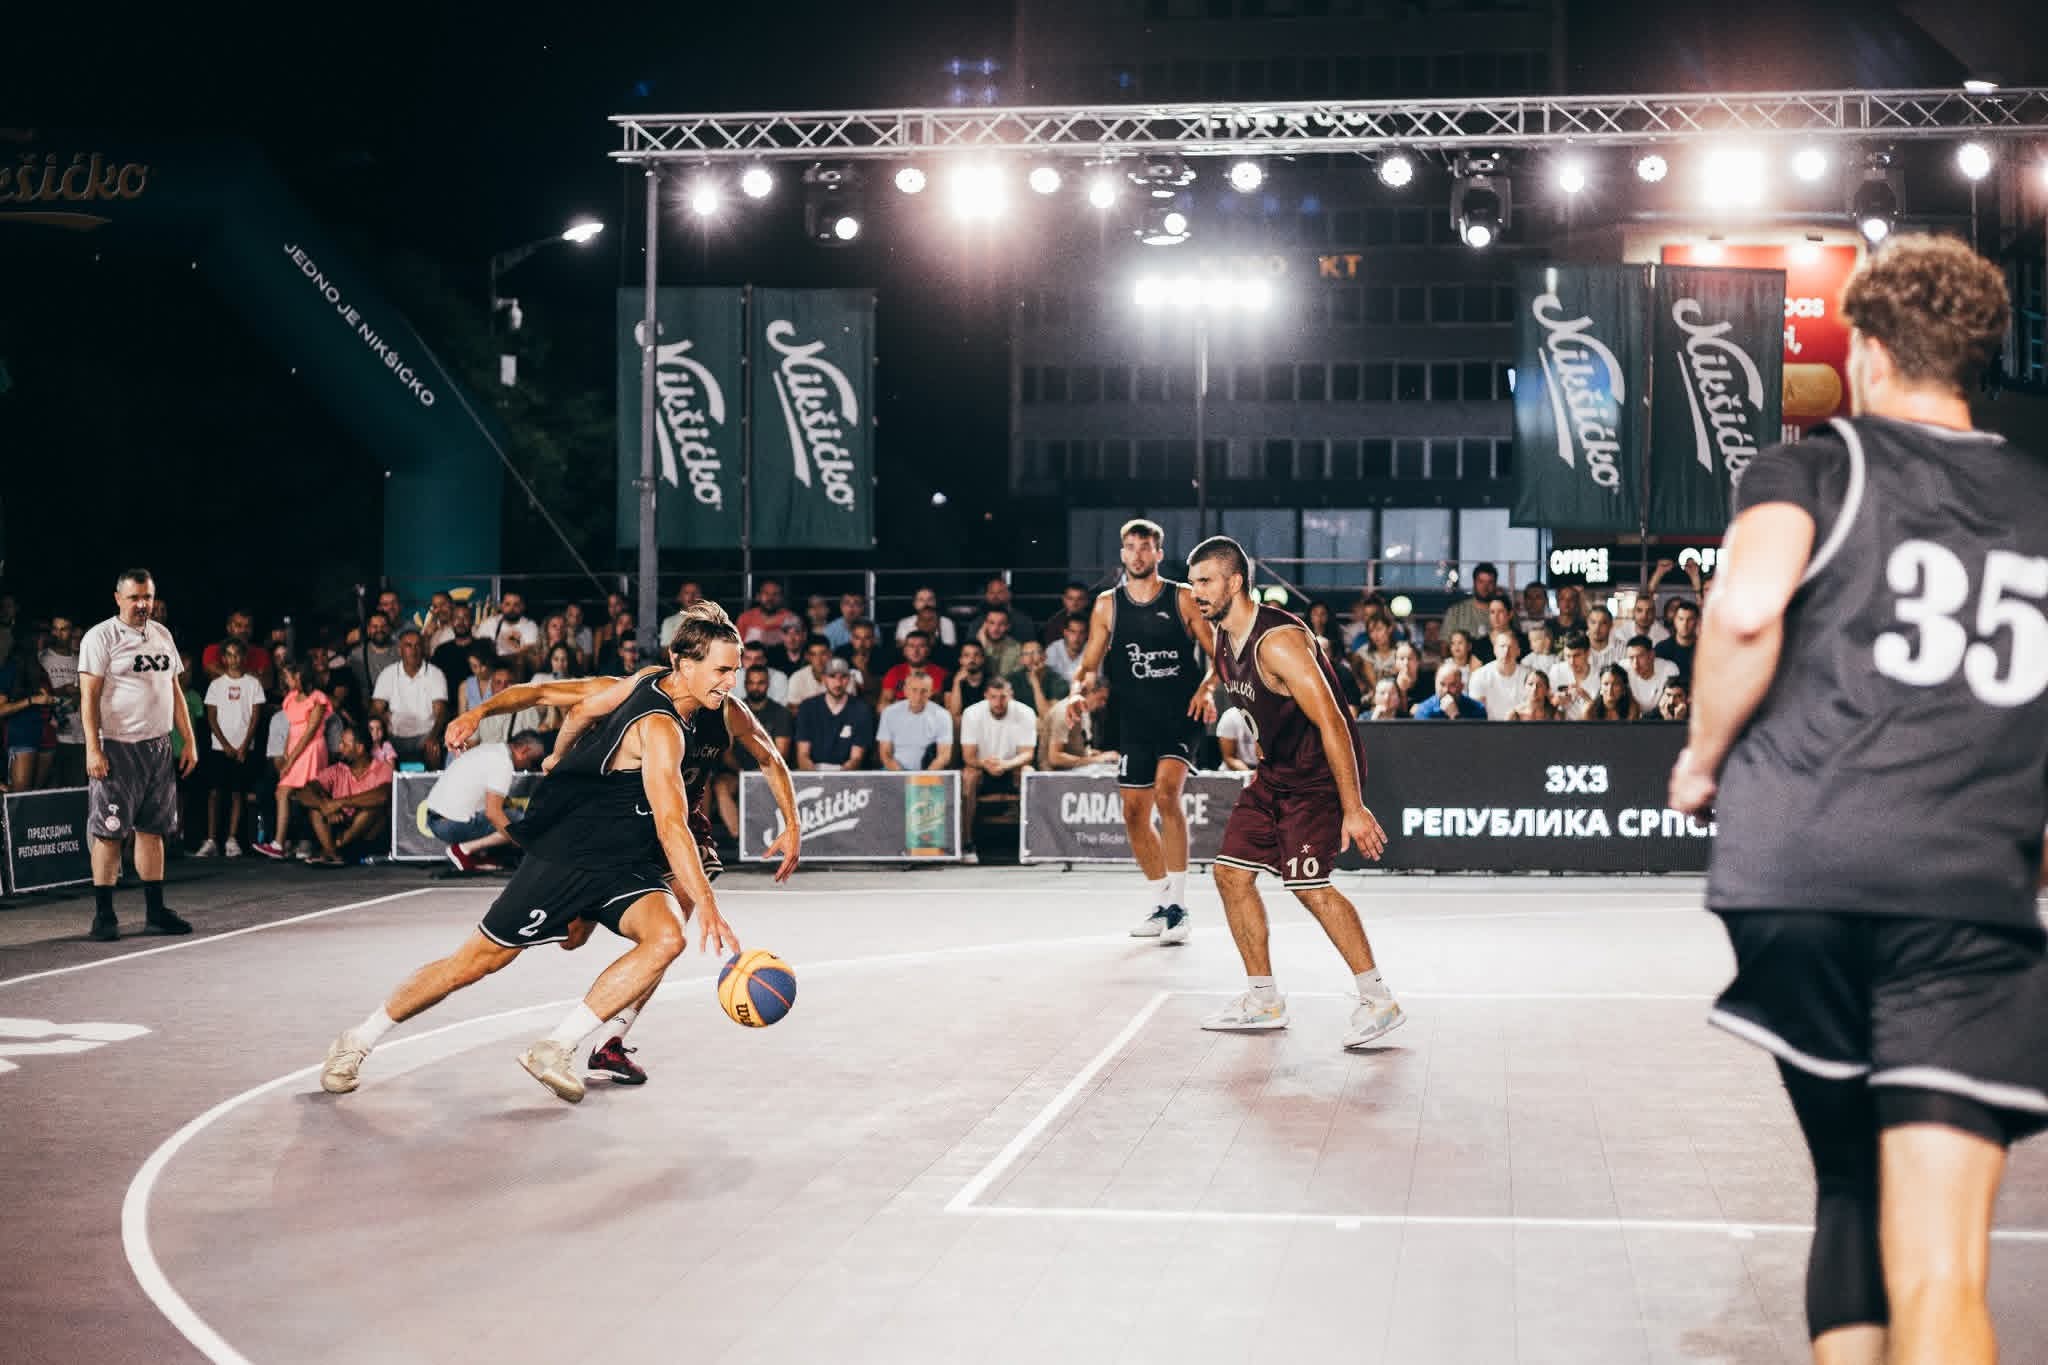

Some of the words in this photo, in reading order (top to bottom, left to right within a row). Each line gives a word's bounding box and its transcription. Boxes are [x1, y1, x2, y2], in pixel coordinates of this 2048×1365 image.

[284, 243, 340, 303] JEDNO
[336, 304, 361, 327] JE
[1672, 298, 1764, 488] Nikšićk
[1873, 538, 2048, 708] 35
[1402, 806, 1612, 838] РЕПУБЛИКА
[1286, 856, 1320, 878] 10
[518, 908, 548, 937] 2
